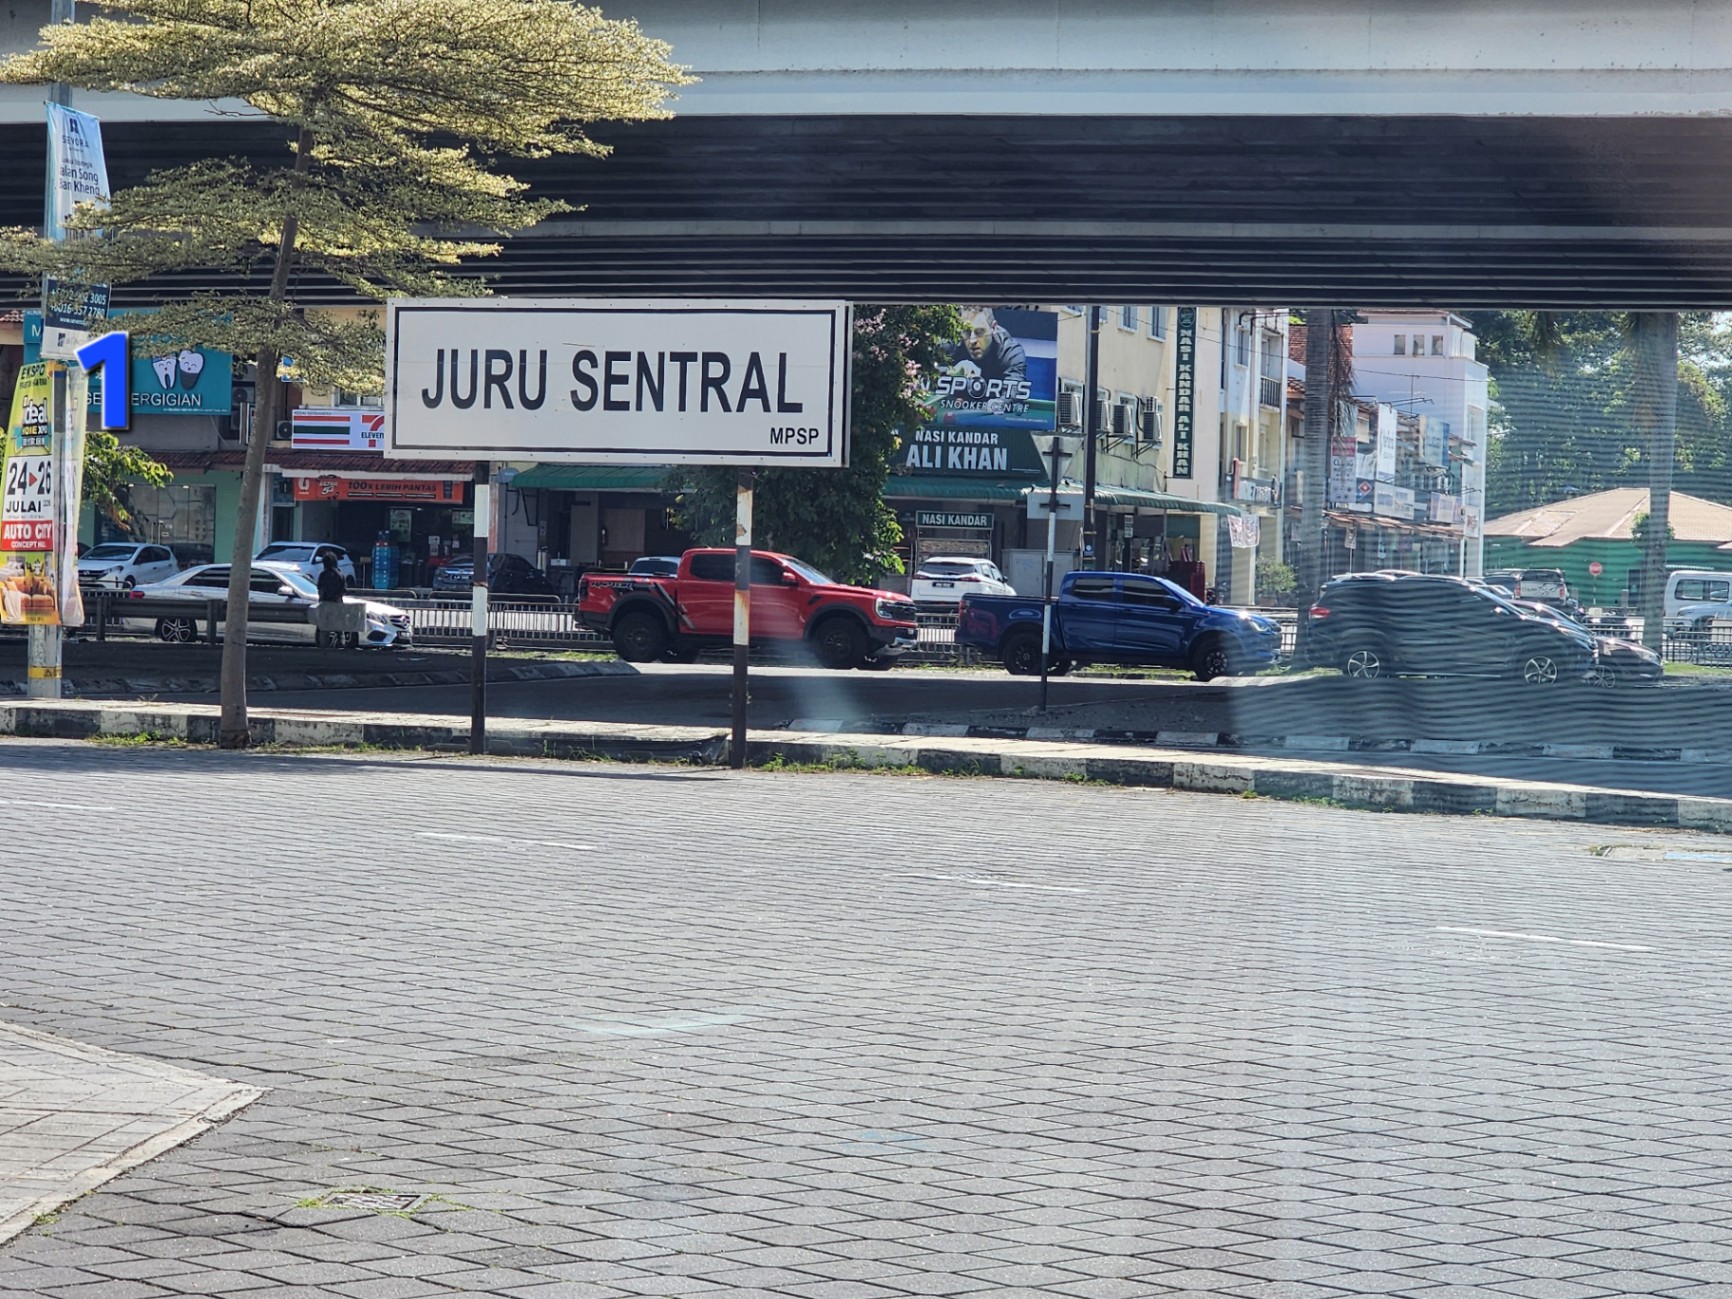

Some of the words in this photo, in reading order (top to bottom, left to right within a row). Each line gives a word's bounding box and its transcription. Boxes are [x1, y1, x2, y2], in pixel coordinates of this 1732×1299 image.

[60, 164, 77, 179] alan
[79, 168, 99, 186] Song
[90, 293, 106, 305] 3005
[1180, 329, 1192, 361] NASI
[421, 348, 547, 411] JURU
[569, 349, 803, 413] SENTRAL
[935, 376, 1032, 400] SPORTS
[1178, 364, 1192, 412] KANDAR
[131, 393, 201, 407] ERGIGIAN
[940, 399, 987, 410] SNOOKER
[989, 402, 1030, 413] CENTRE
[769, 427, 820, 445] MPSP
[1177, 415, 1190, 439] ALI
[915, 430, 944, 442] NASI
[948, 431, 999, 445] KANDAR
[906, 444, 942, 469] ALI
[947, 446, 1008, 471] KHAN
[1176, 442, 1190, 475] KHAN
[7, 461, 28, 495] 24
[37, 460, 51, 495] 26
[402, 484, 437, 492] PANTAS
[6, 500, 41, 513] JULAI
[922, 513, 945, 525] NASI
[948, 514, 987, 526] KANDAR
[4, 523, 32, 540] AUTO
